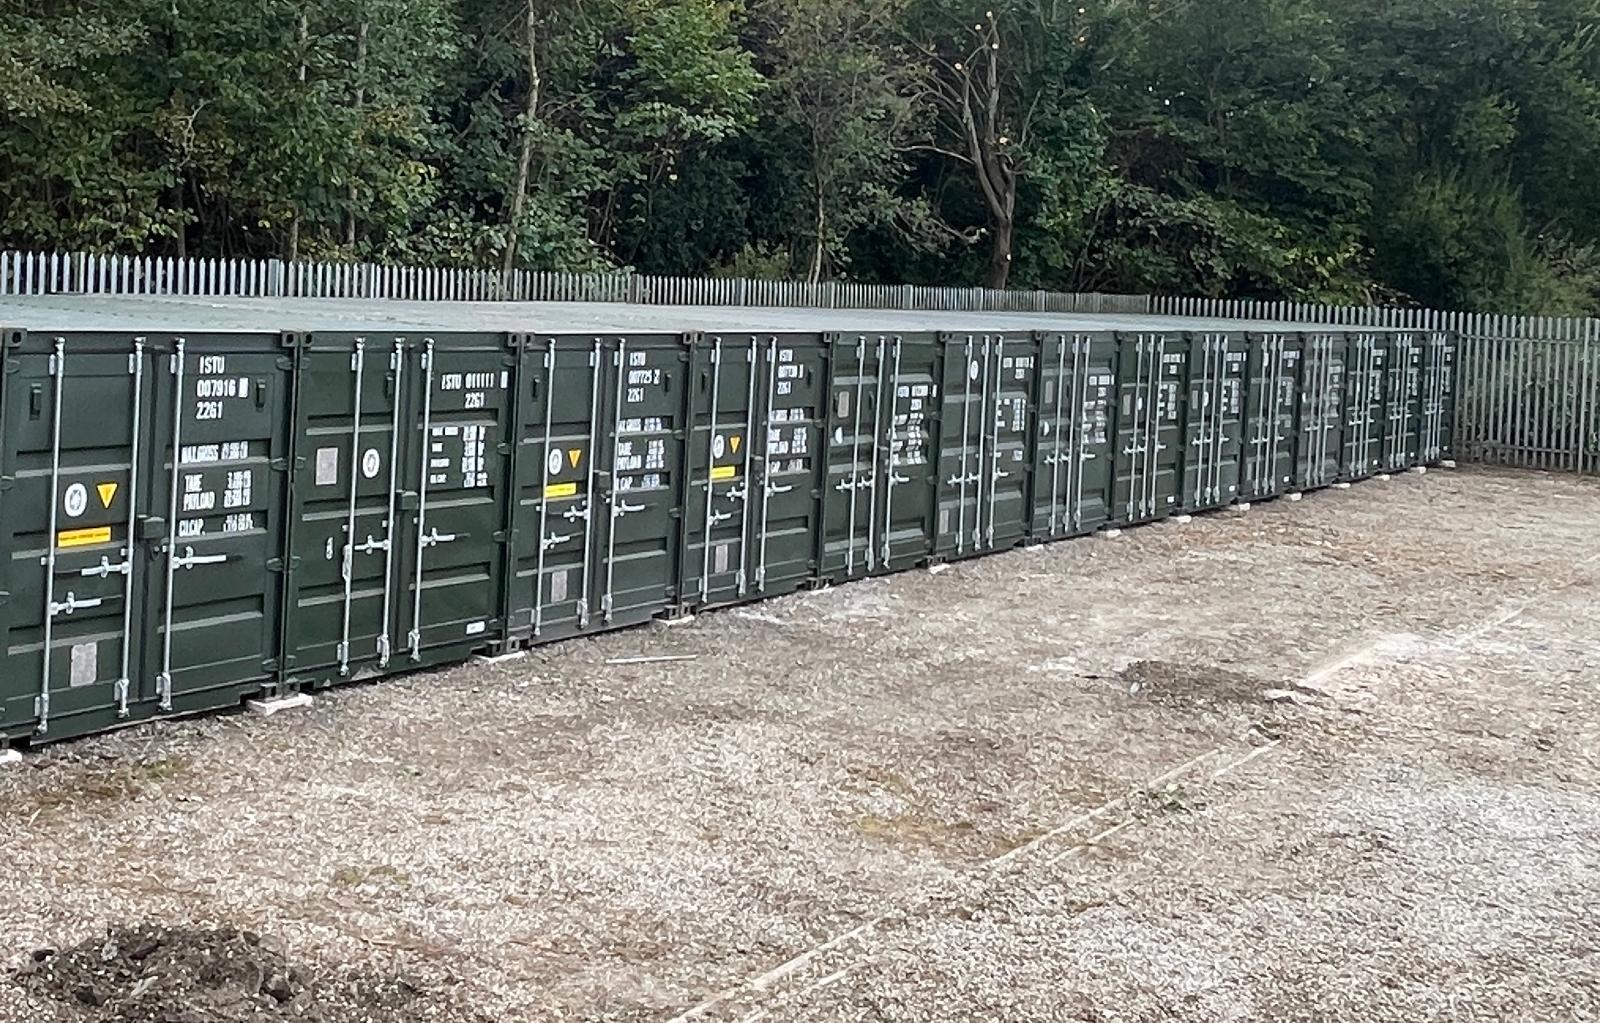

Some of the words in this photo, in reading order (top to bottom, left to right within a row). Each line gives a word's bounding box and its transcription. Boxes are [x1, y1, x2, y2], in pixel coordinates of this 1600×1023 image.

[199, 355, 225, 374] ISTU
[196, 378, 236, 398] 007916
[441, 373, 462, 390] ISTU
